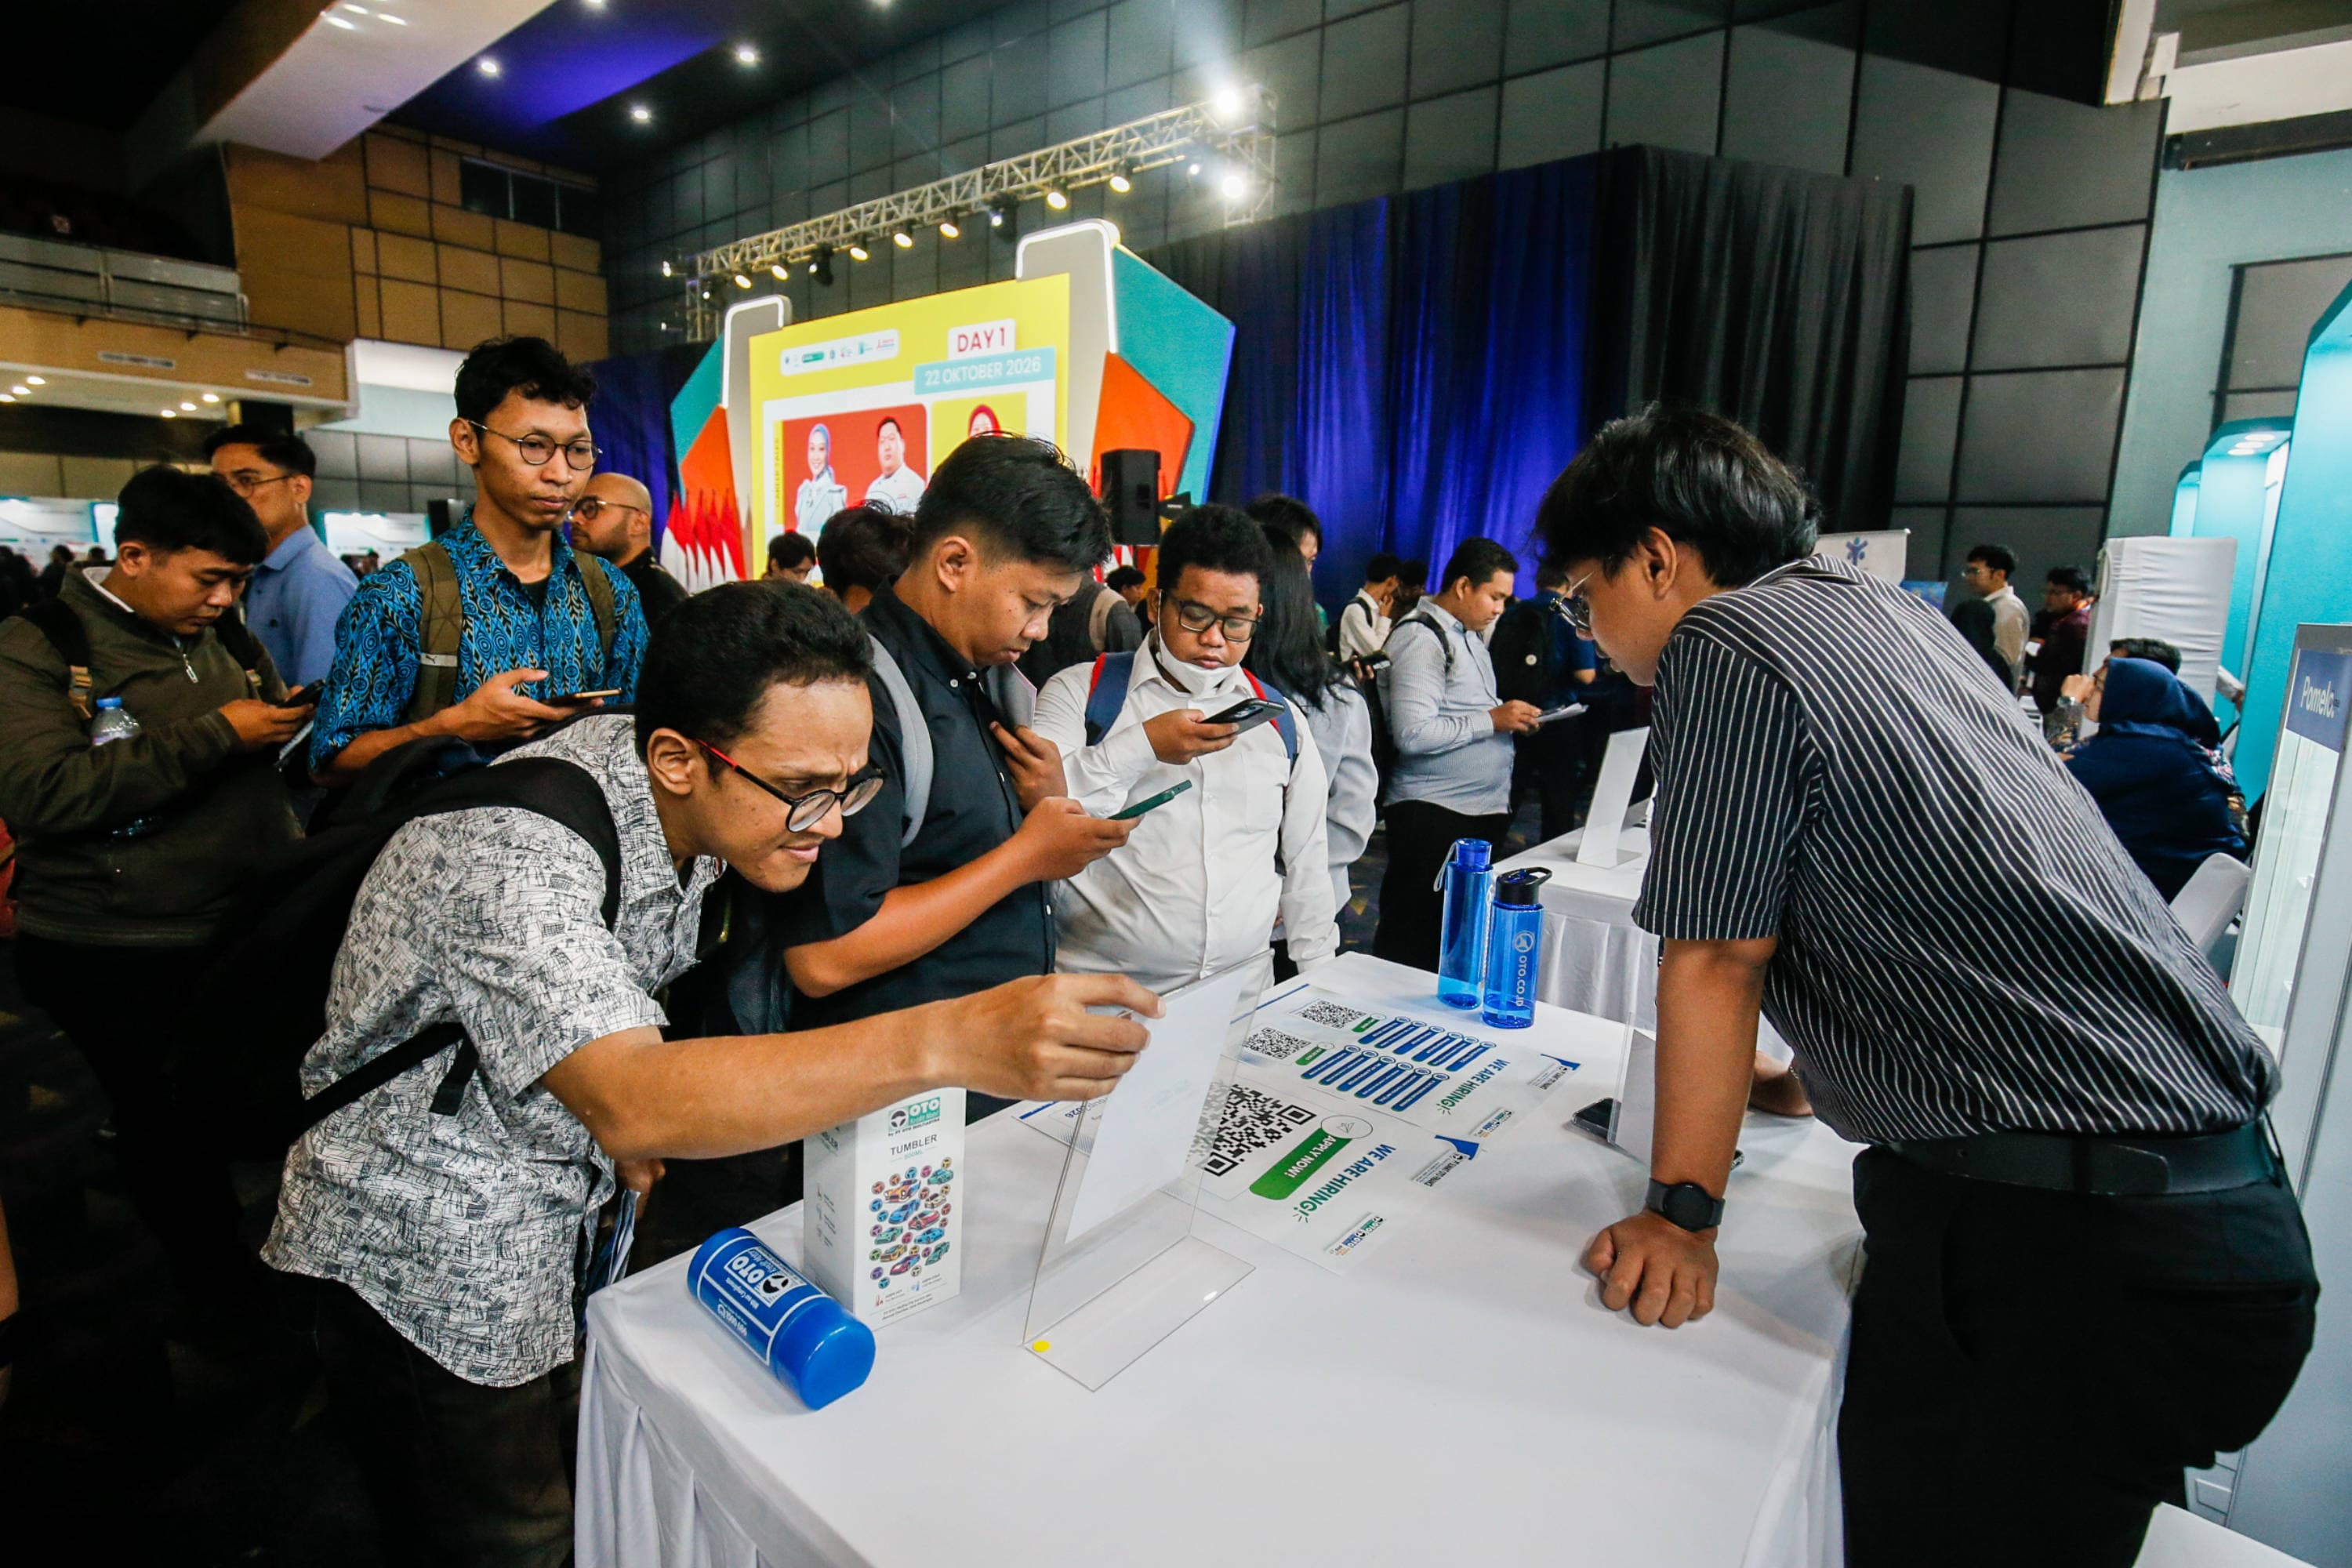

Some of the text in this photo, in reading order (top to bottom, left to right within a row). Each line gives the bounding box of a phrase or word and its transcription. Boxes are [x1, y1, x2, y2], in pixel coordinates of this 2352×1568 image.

[957, 326, 1005, 352] DAY 1
[925, 356, 1041, 386] 22 OKTOBER 2026
[1515, 955, 1528, 1007] OTO.CO.ID
[1471, 1068, 1495, 1083] ARE
[1489, 1059, 1511, 1071] WE
[909, 1098, 940, 1116] OTO
[1437, 1080, 1480, 1109] HIRING!
[891, 1134, 938, 1156] TUMBLER
[1284, 1135, 1337, 1178] APPLY NOW!
[1293, 1144, 1396, 1217] WE ARE HIRING!
[731, 1255, 765, 1284] OTO
